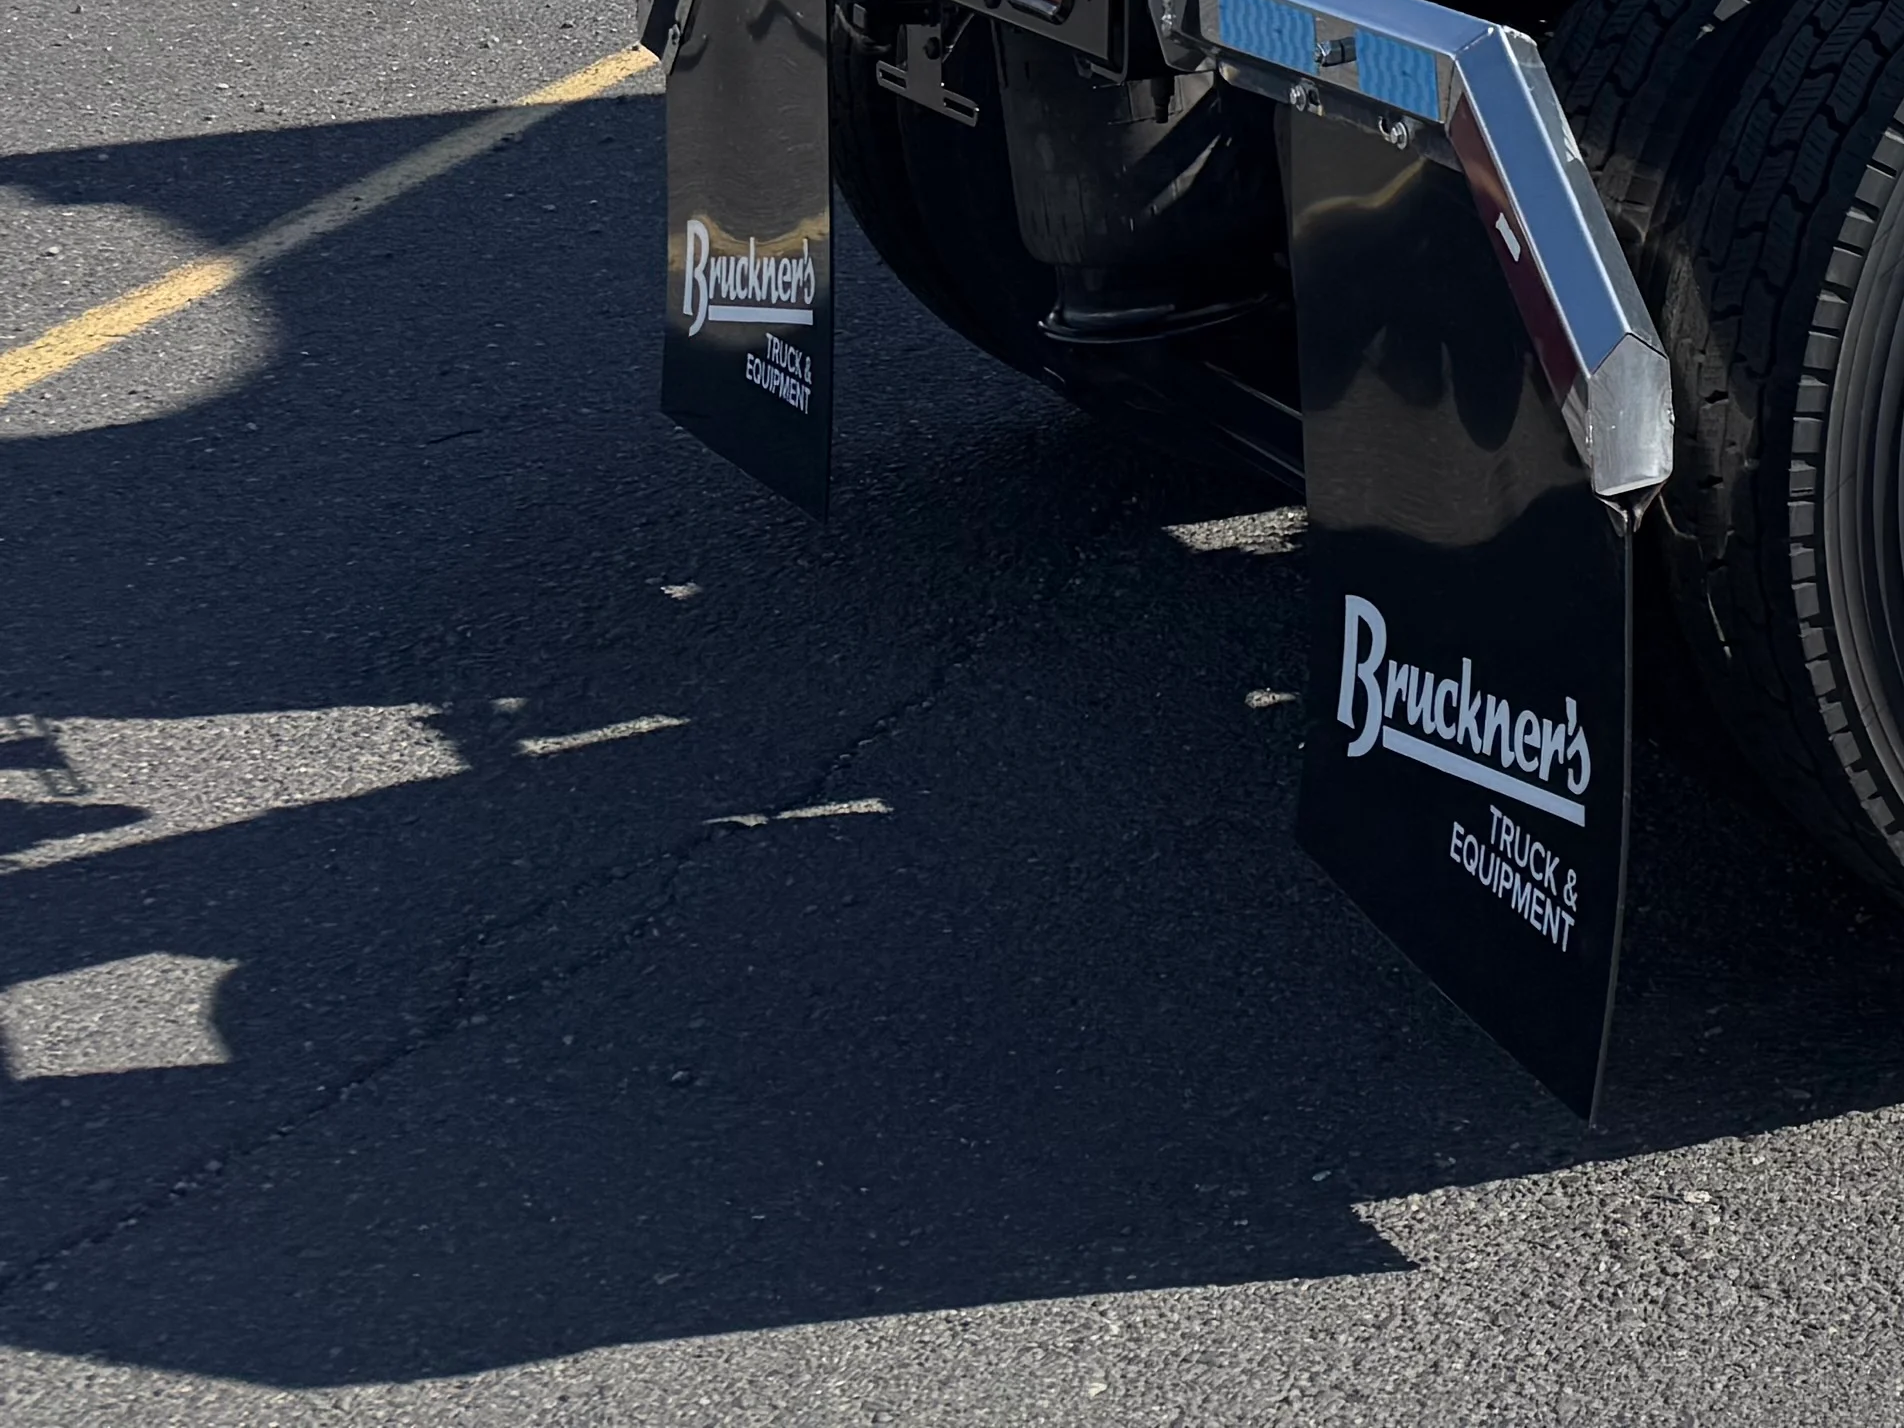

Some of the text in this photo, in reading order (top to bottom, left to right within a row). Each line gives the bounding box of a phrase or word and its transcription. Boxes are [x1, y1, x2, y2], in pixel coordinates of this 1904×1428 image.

[683, 219, 816, 337] Bruckner's
[745, 352, 812, 415] EQUIPMENT
[765, 332, 813, 385] TRUCK &
[1336, 593, 1592, 796] Bruckner's
[1450, 820, 1576, 953] EQUIPMENT
[1489, 804, 1579, 913] TRUCK &
